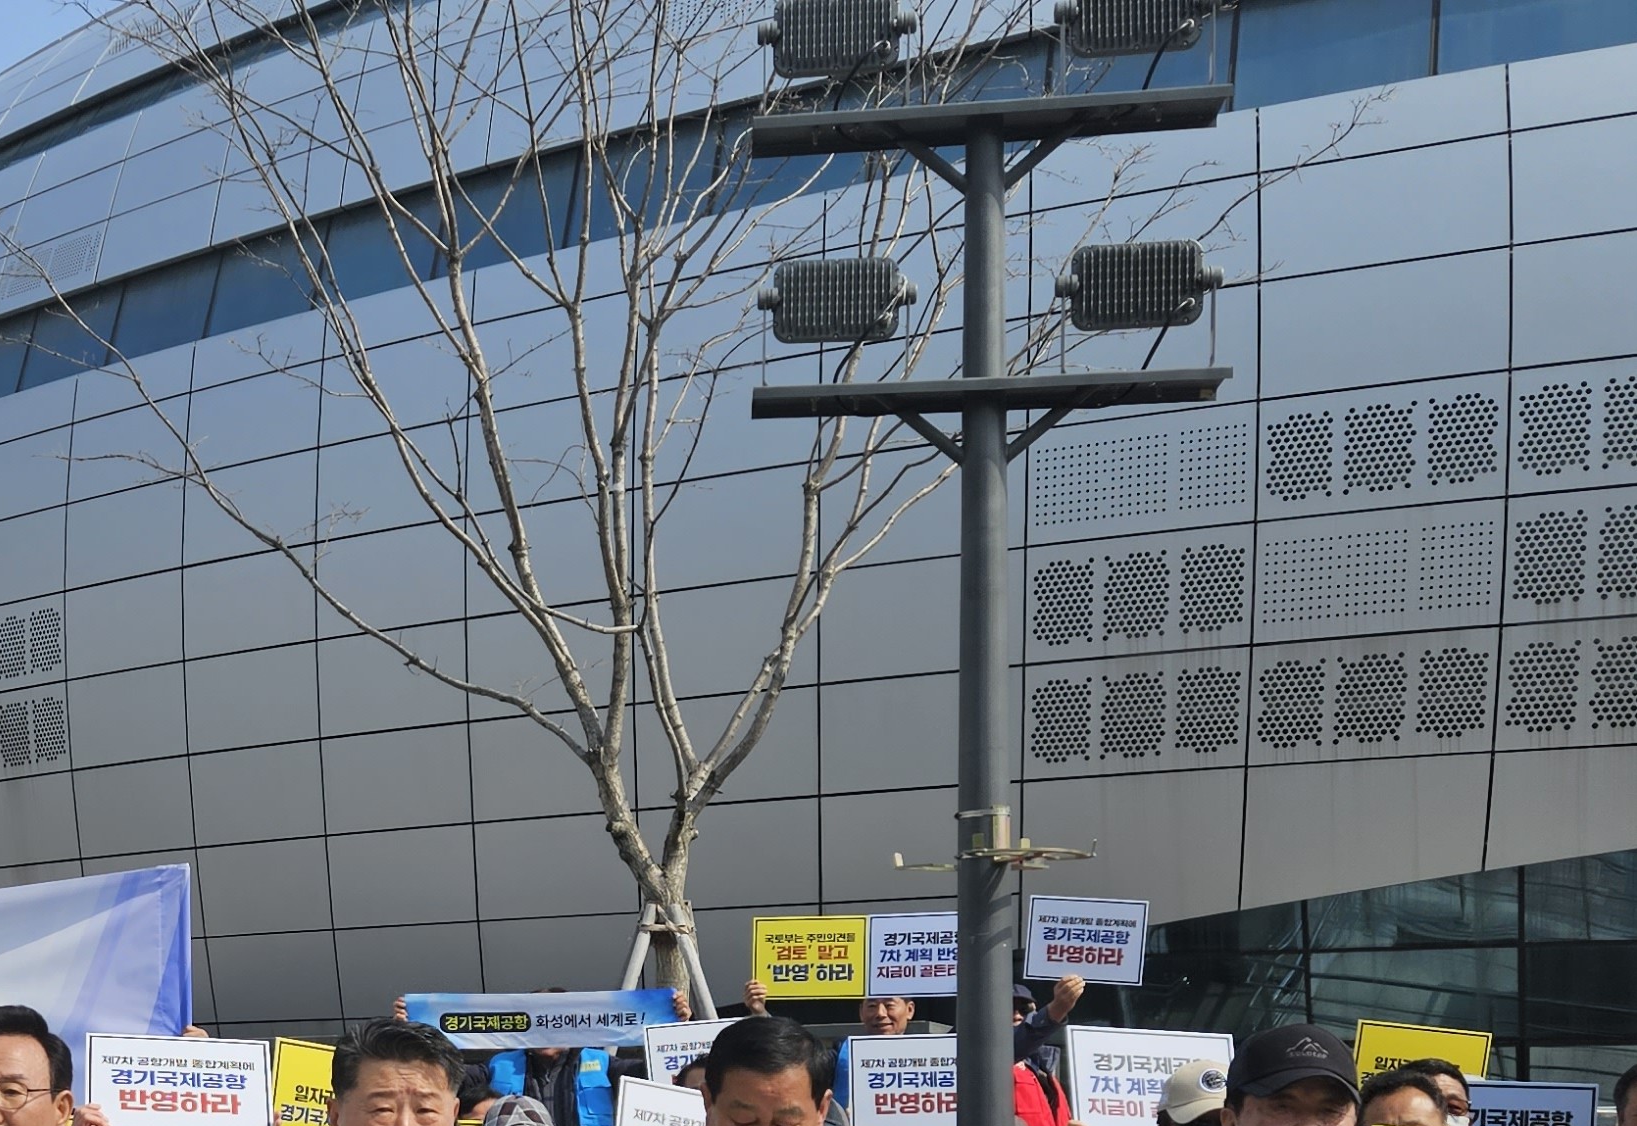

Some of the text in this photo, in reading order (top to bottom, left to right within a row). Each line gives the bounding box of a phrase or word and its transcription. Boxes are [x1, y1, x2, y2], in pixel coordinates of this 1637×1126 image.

[1038, 915, 1059, 924] 제7차
[764, 933, 803, 944] 국토부는
[1043, 927, 1130, 945] 경기국제공항
[818, 945, 849, 960] 말고
[880, 949, 901, 963] 7차
[905, 948, 933, 962] 계획
[1046, 944, 1124, 966] 반영하라
[876, 966, 916, 979] 지금이
[445, 1014, 528, 1031] 경기국제공항
[536, 1012, 592, 1029] 화성에서
[101, 1055, 133, 1066] 제7차
[860, 1058, 885, 1068] 제7차
[111, 1069, 248, 1090] 경기국제공항
[868, 1071, 956, 1089] 경기국제공
[1090, 1075, 1120, 1094] 7차
[119, 1088, 241, 1115] 반영하라
[1088, 1098, 1144, 1118] 지금이
[633, 1108, 666, 1126] 제7차
